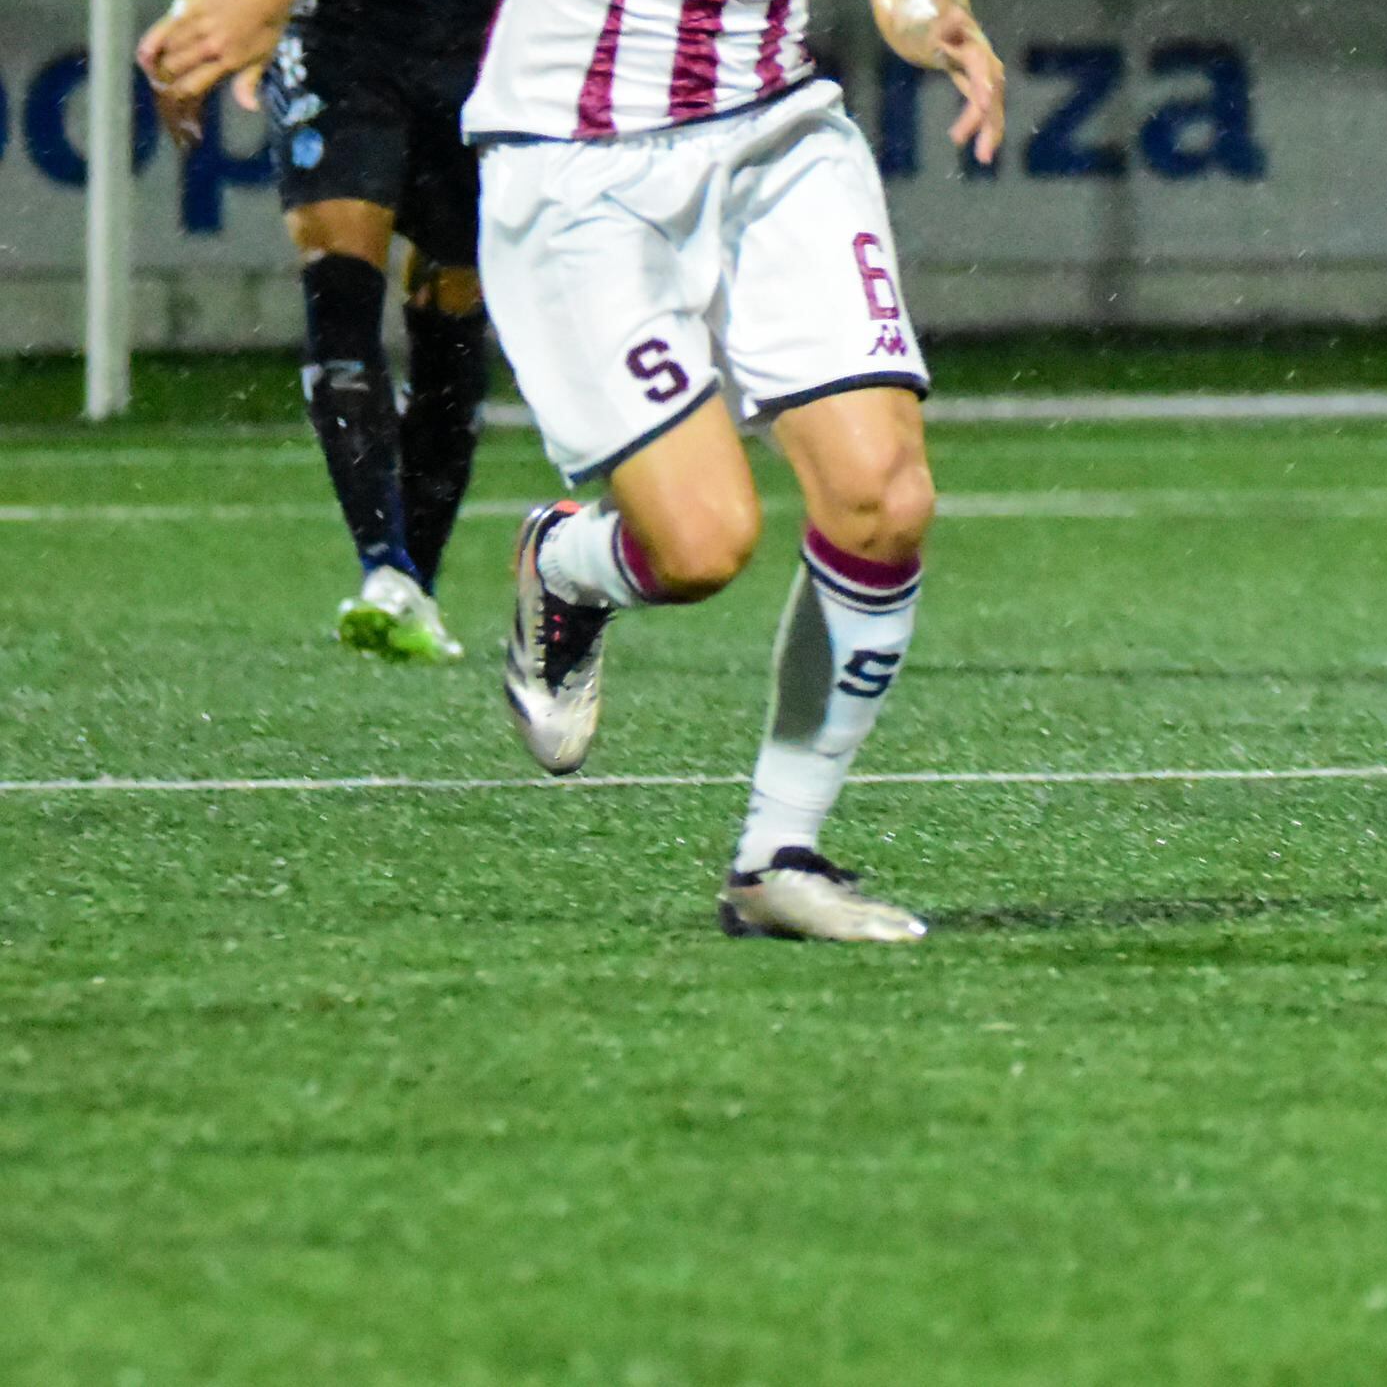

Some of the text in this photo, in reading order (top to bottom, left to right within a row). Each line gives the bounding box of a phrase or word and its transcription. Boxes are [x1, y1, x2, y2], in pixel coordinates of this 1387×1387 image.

[852, 231, 900, 321] 6
[625, 337, 690, 404] S
[835, 648, 902, 699] S
